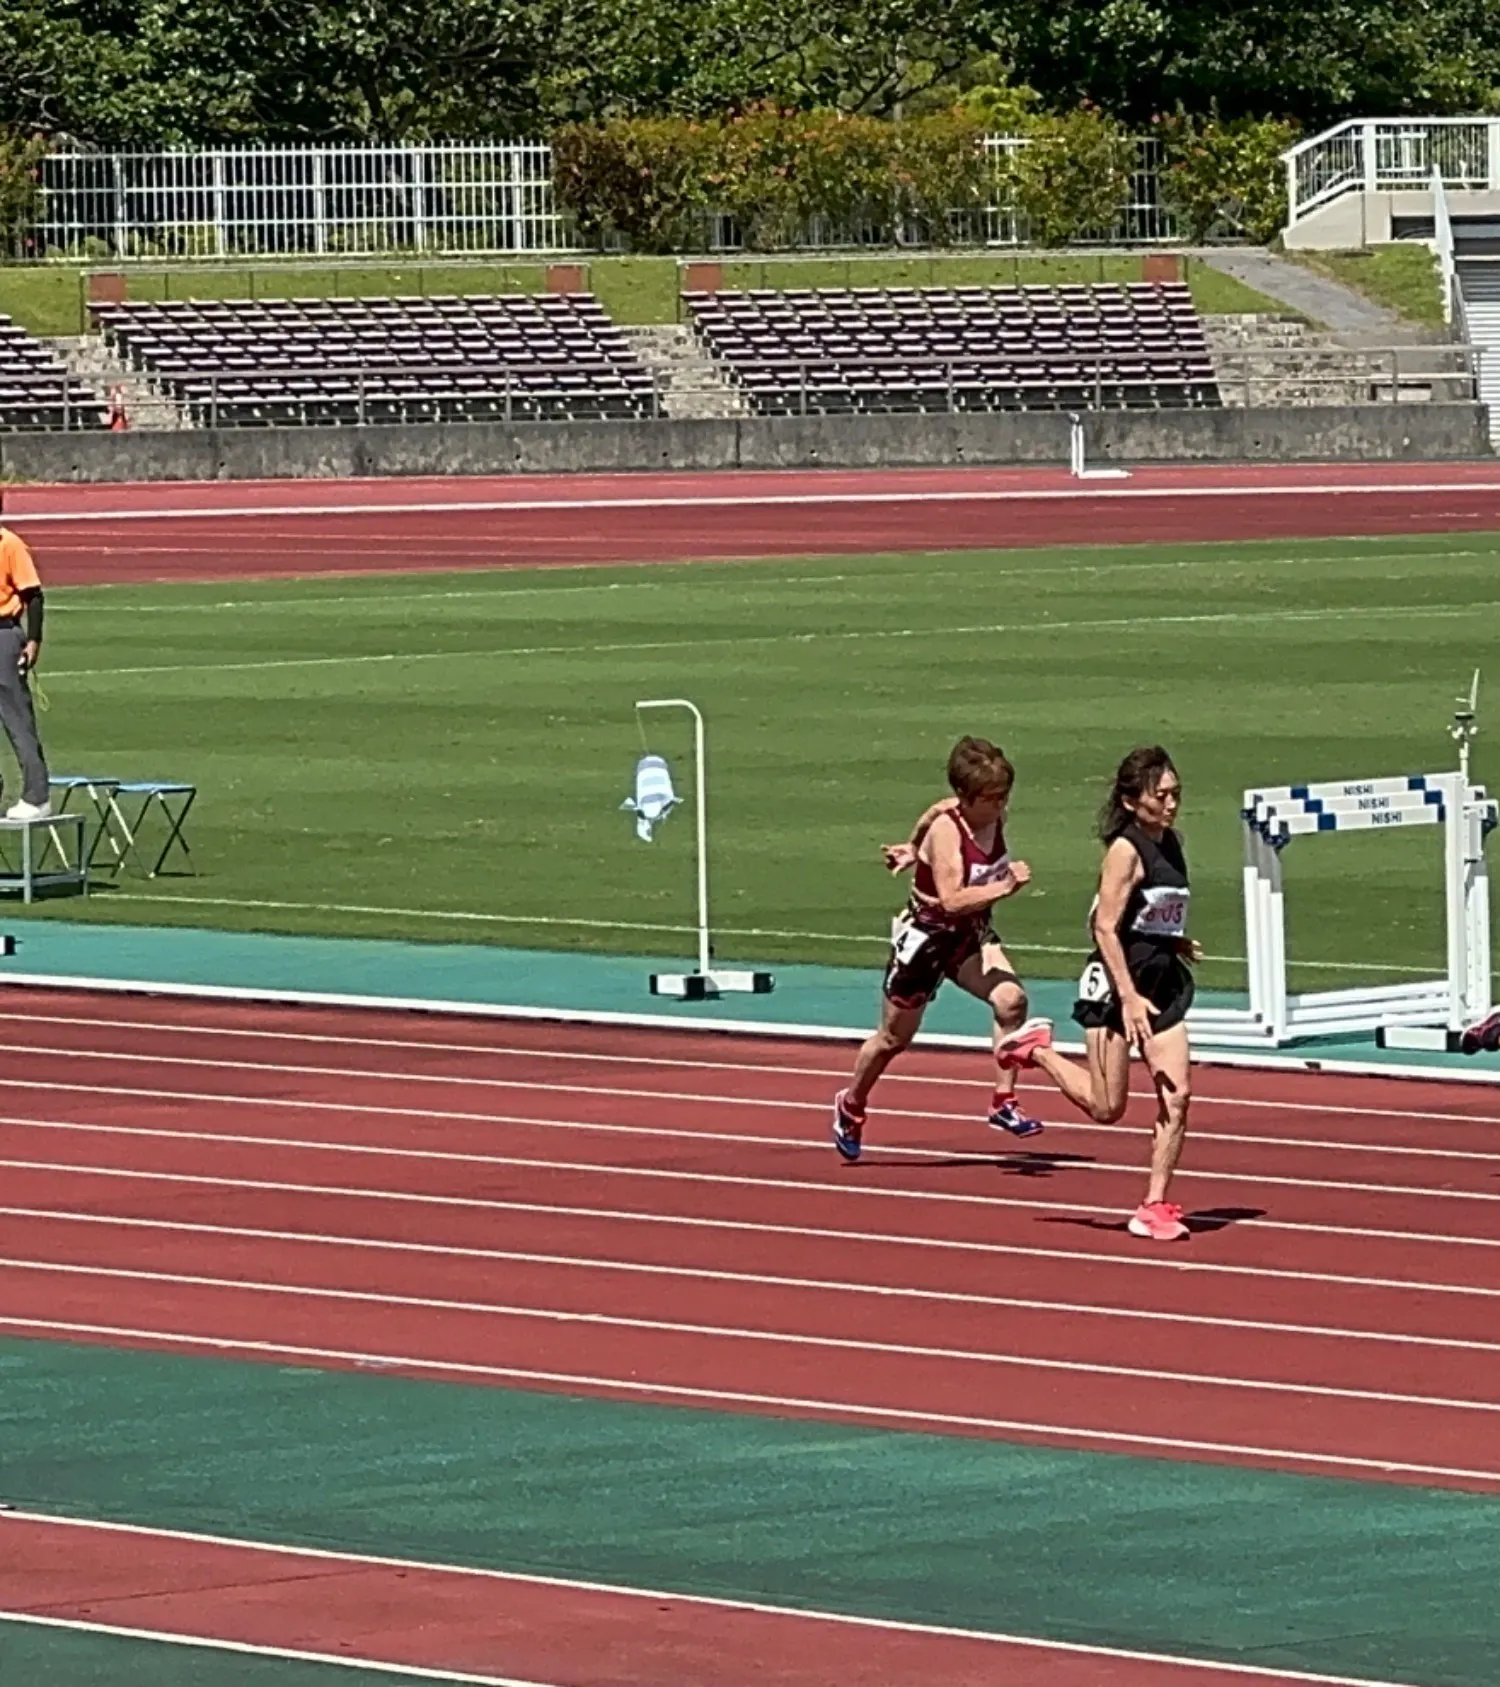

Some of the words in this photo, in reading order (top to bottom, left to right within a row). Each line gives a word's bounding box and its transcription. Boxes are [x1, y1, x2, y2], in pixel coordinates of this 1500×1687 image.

[1343, 784, 1374, 796] NISHI
[1358, 797, 1390, 810] NISHI
[1372, 811, 1402, 825] NISHI
[896, 931, 909, 953] 4
[1087, 965, 1101, 996] 5
